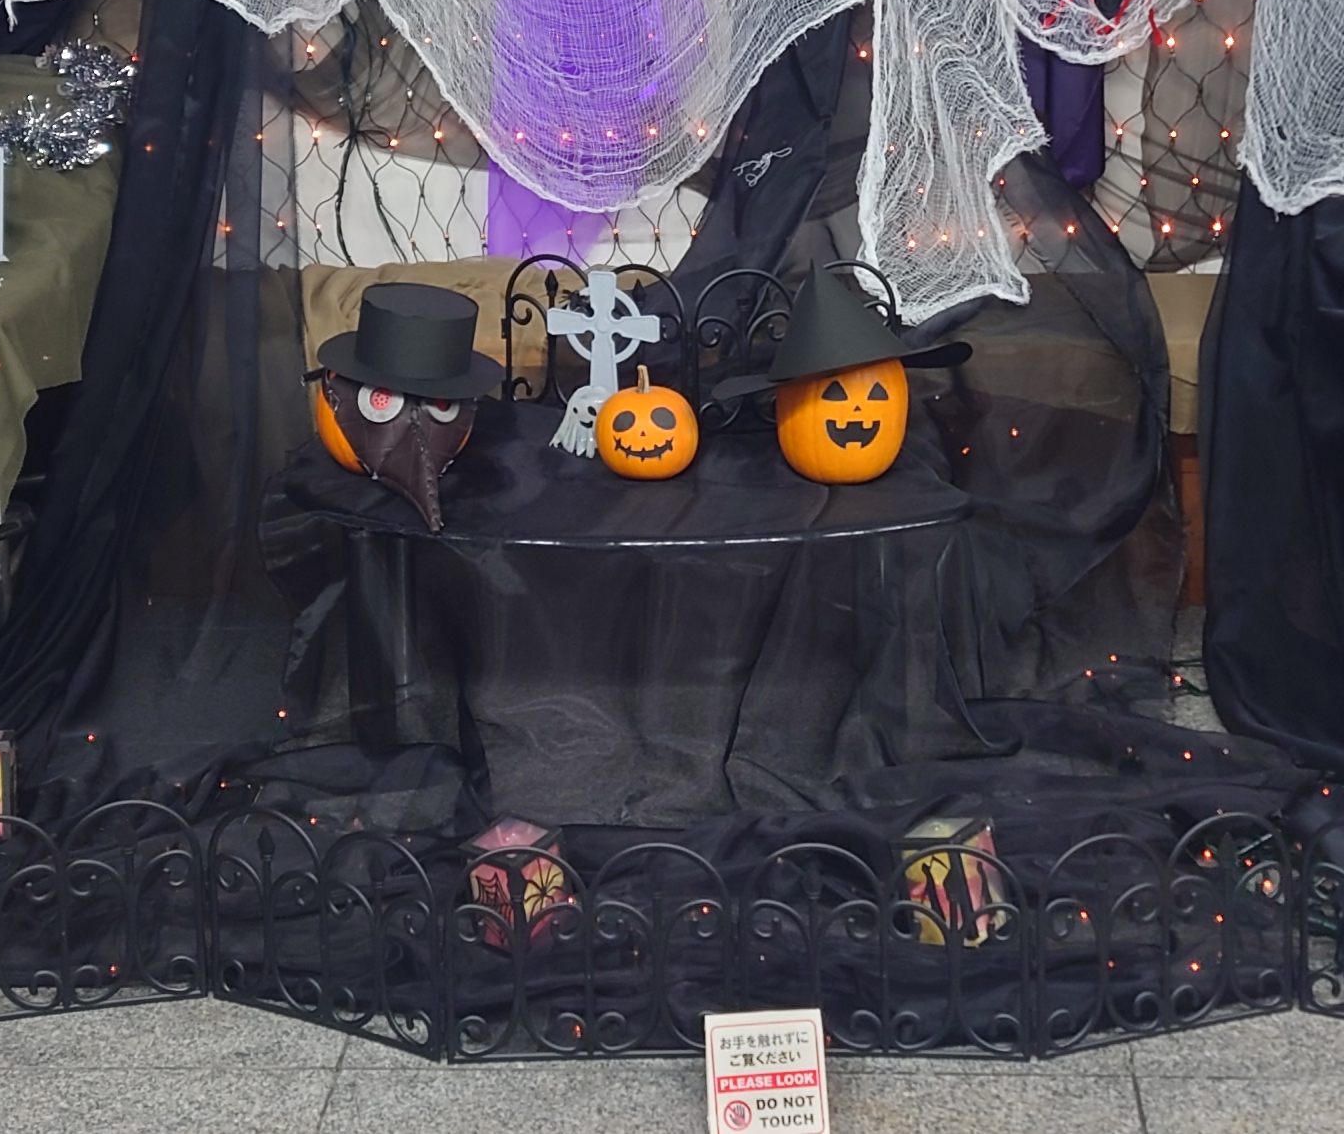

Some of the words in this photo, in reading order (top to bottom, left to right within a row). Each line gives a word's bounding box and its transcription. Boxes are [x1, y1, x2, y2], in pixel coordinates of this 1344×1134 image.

[719, 1031, 808, 1049] お手を触れずに
[729, 1051, 800, 1066] ご覧ください
[720, 1075, 772, 1090] PLEASE
[776, 1072, 814, 1085] LOOK
[756, 1097, 777, 1109] DO
[783, 1095, 814, 1107] NOT
[759, 1114, 814, 1127] TOUCH
